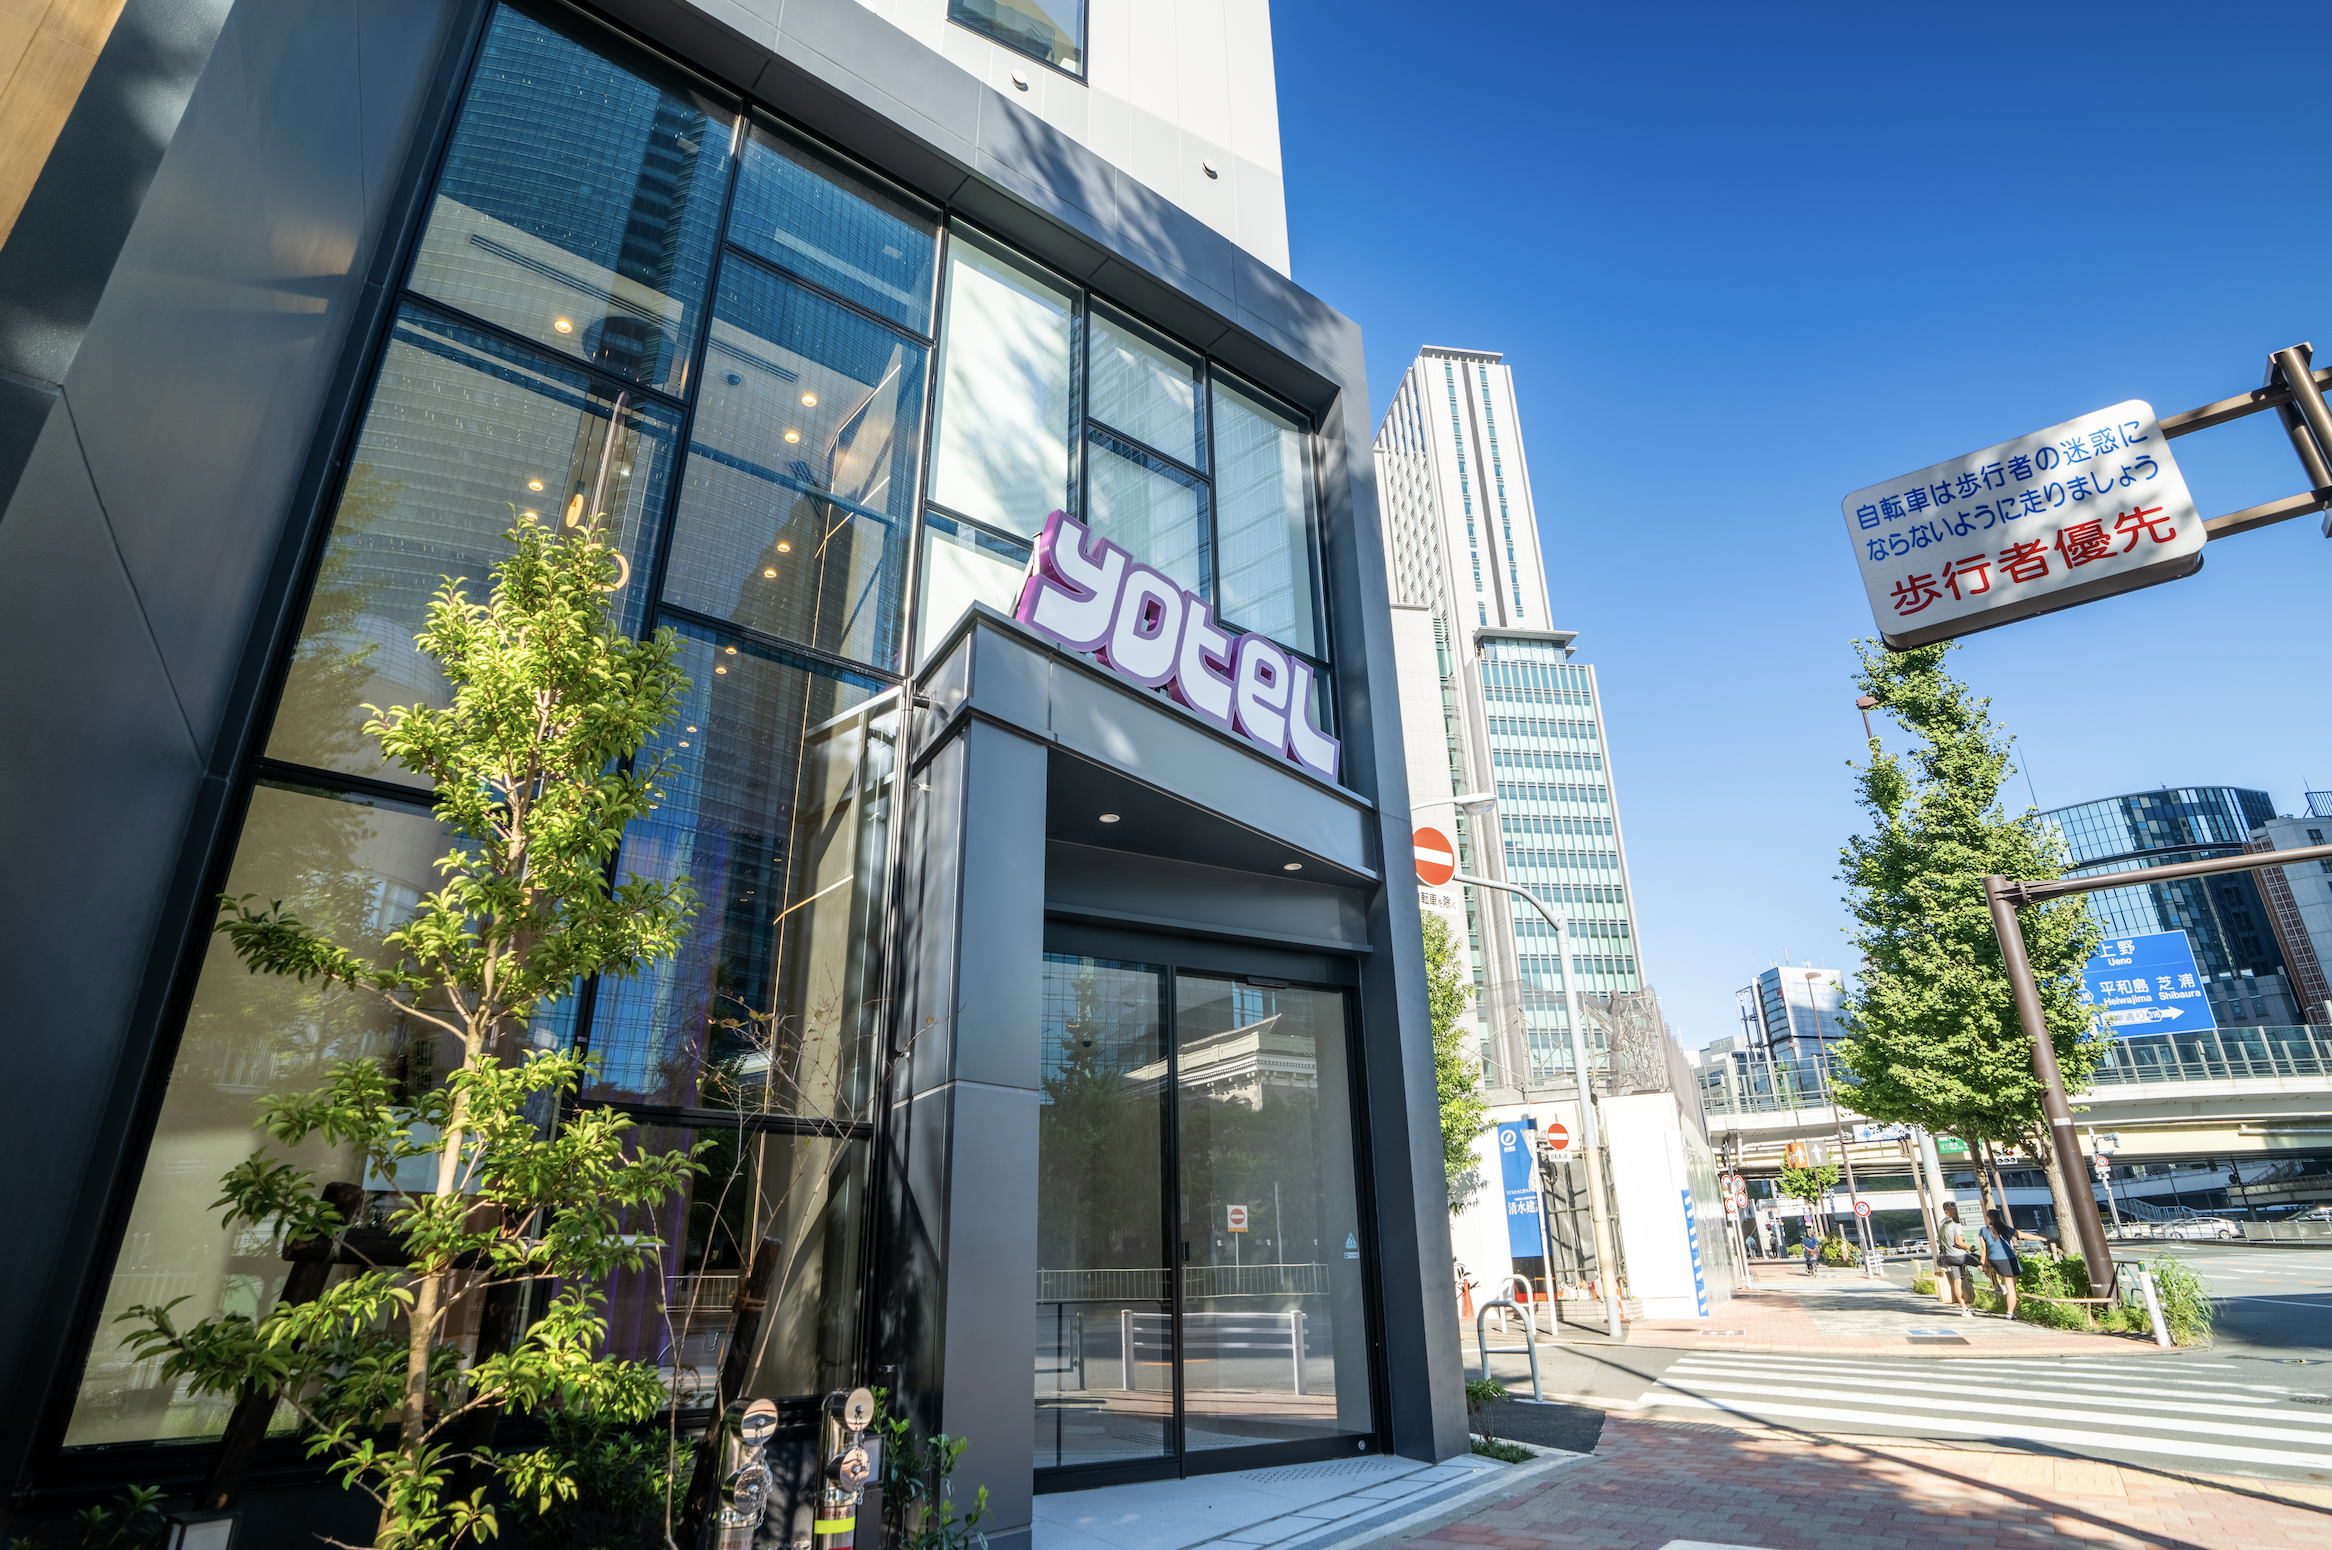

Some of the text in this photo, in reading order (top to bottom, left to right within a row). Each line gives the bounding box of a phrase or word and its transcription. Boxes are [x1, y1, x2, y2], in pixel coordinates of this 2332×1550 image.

[1856, 419, 2149, 530] 自転車は歩行者の迷惑に
[1866, 454, 2160, 561] ならないように走りましょう
[1890, 505, 2177, 616] 歩行者優先
[1420, 891, 1457, 910] 転車を除く
[2099, 940, 2135, 958] 上野
[2107, 957, 2132, 967] Ueno
[2098, 973, 2196, 996] 平和島 芝浦
[2103, 989, 2201, 1006] Heiwajima Shibaura
[2147, 1010, 2161, 1019] 316
[1508, 1199, 1539, 1215] 清水建
